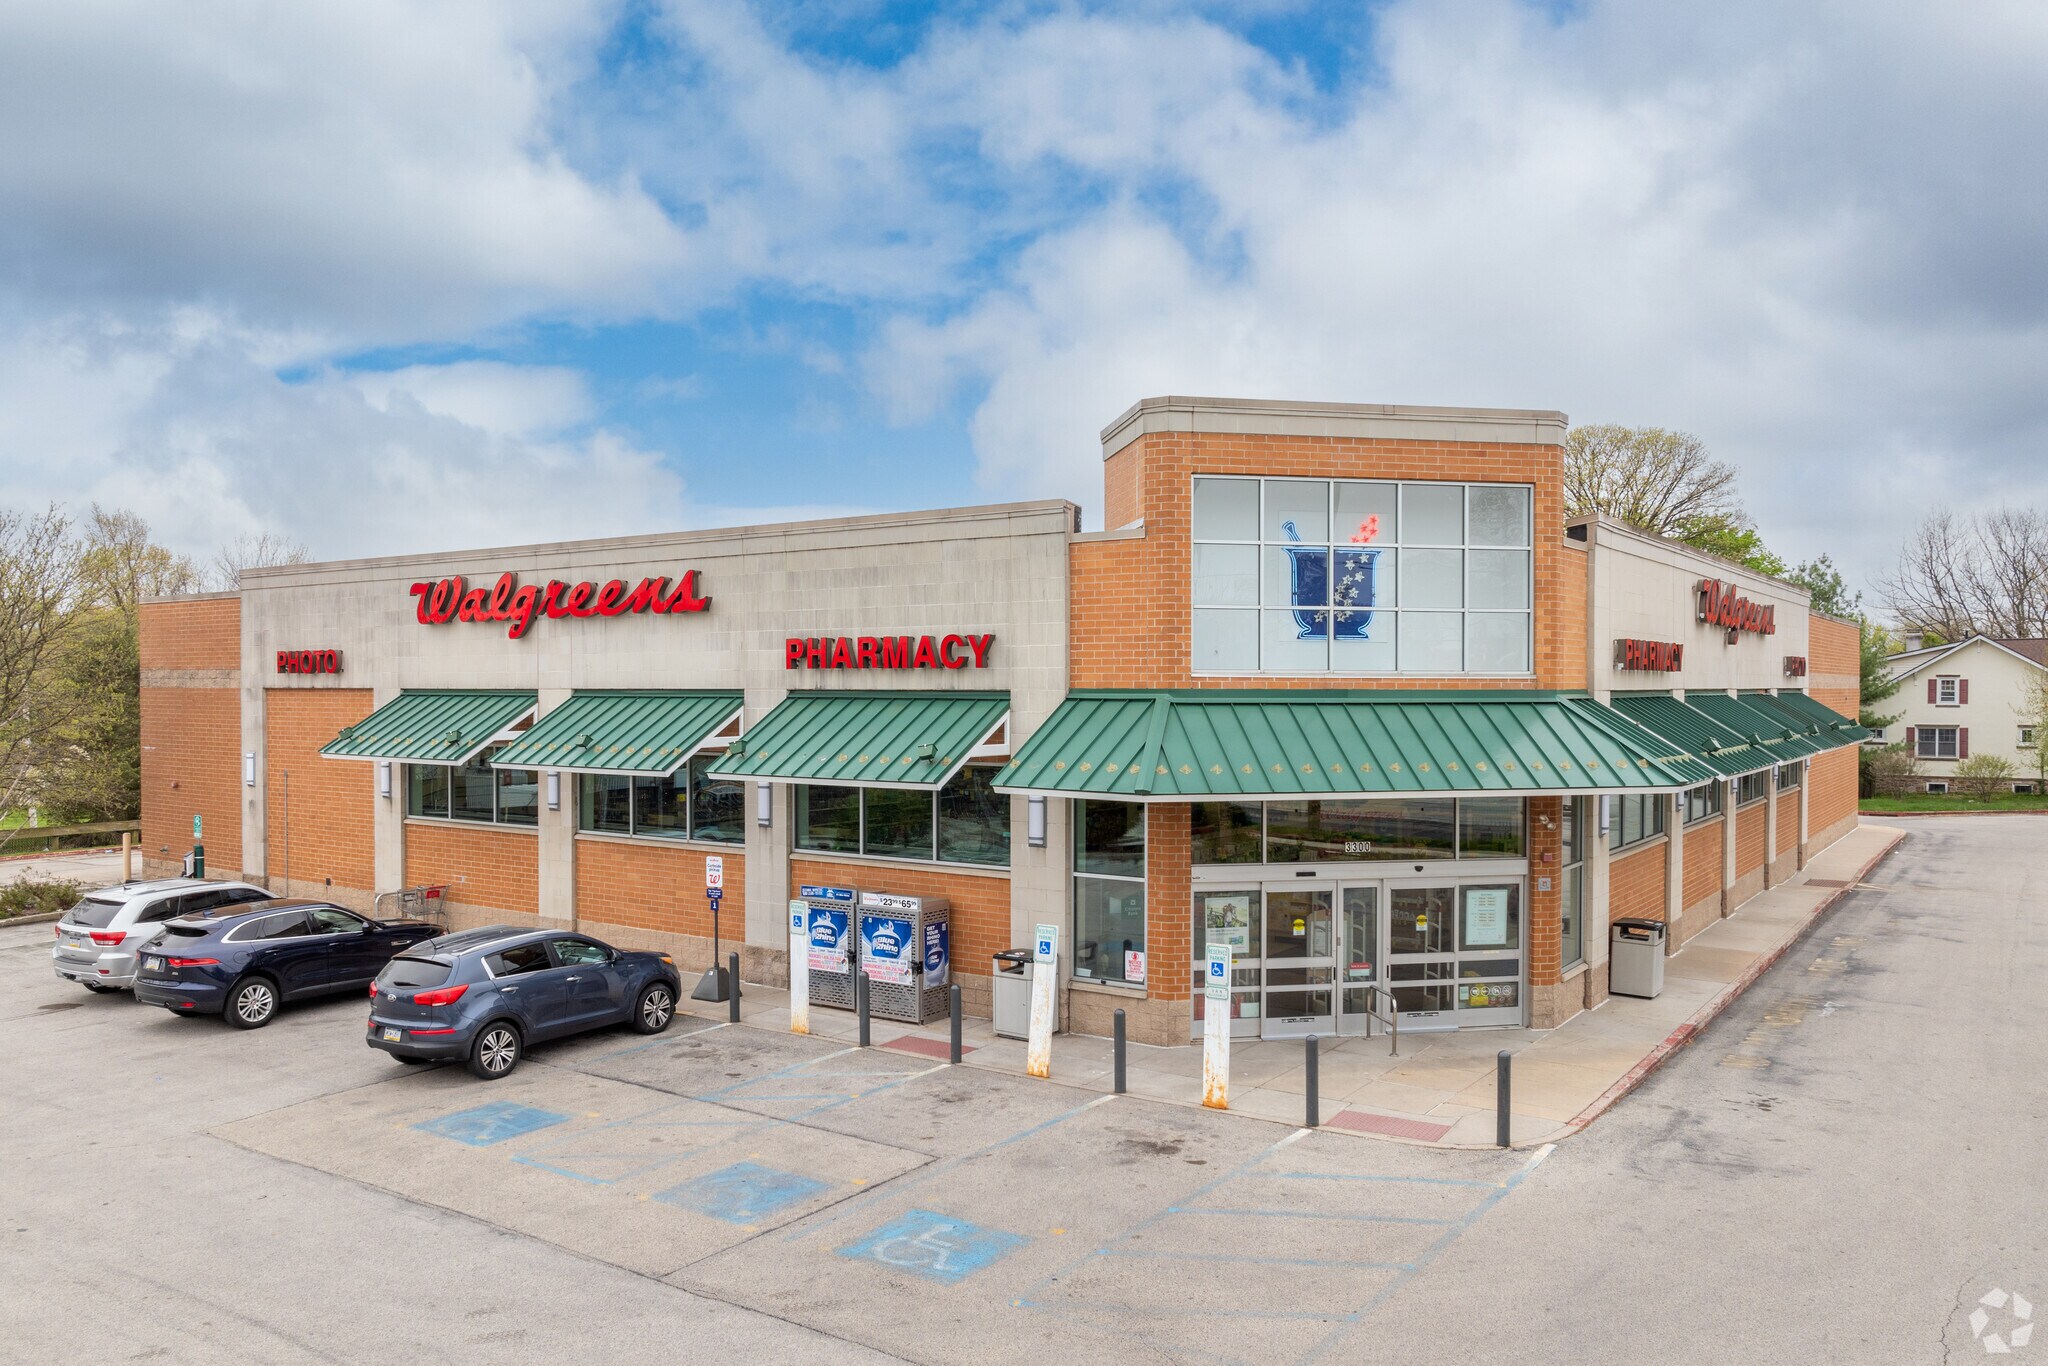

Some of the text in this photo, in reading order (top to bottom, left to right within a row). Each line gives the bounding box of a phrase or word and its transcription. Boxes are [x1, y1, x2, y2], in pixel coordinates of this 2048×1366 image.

[410, 570, 709, 639] Walgreens
[1696, 578, 1775, 645] Walgreens
[277, 649, 341, 674] PHOTO
[786, 634, 995, 670] PHARMACY
[1619, 638, 1683, 672] PHARMACY
[1345, 841, 1371, 852] 3300
